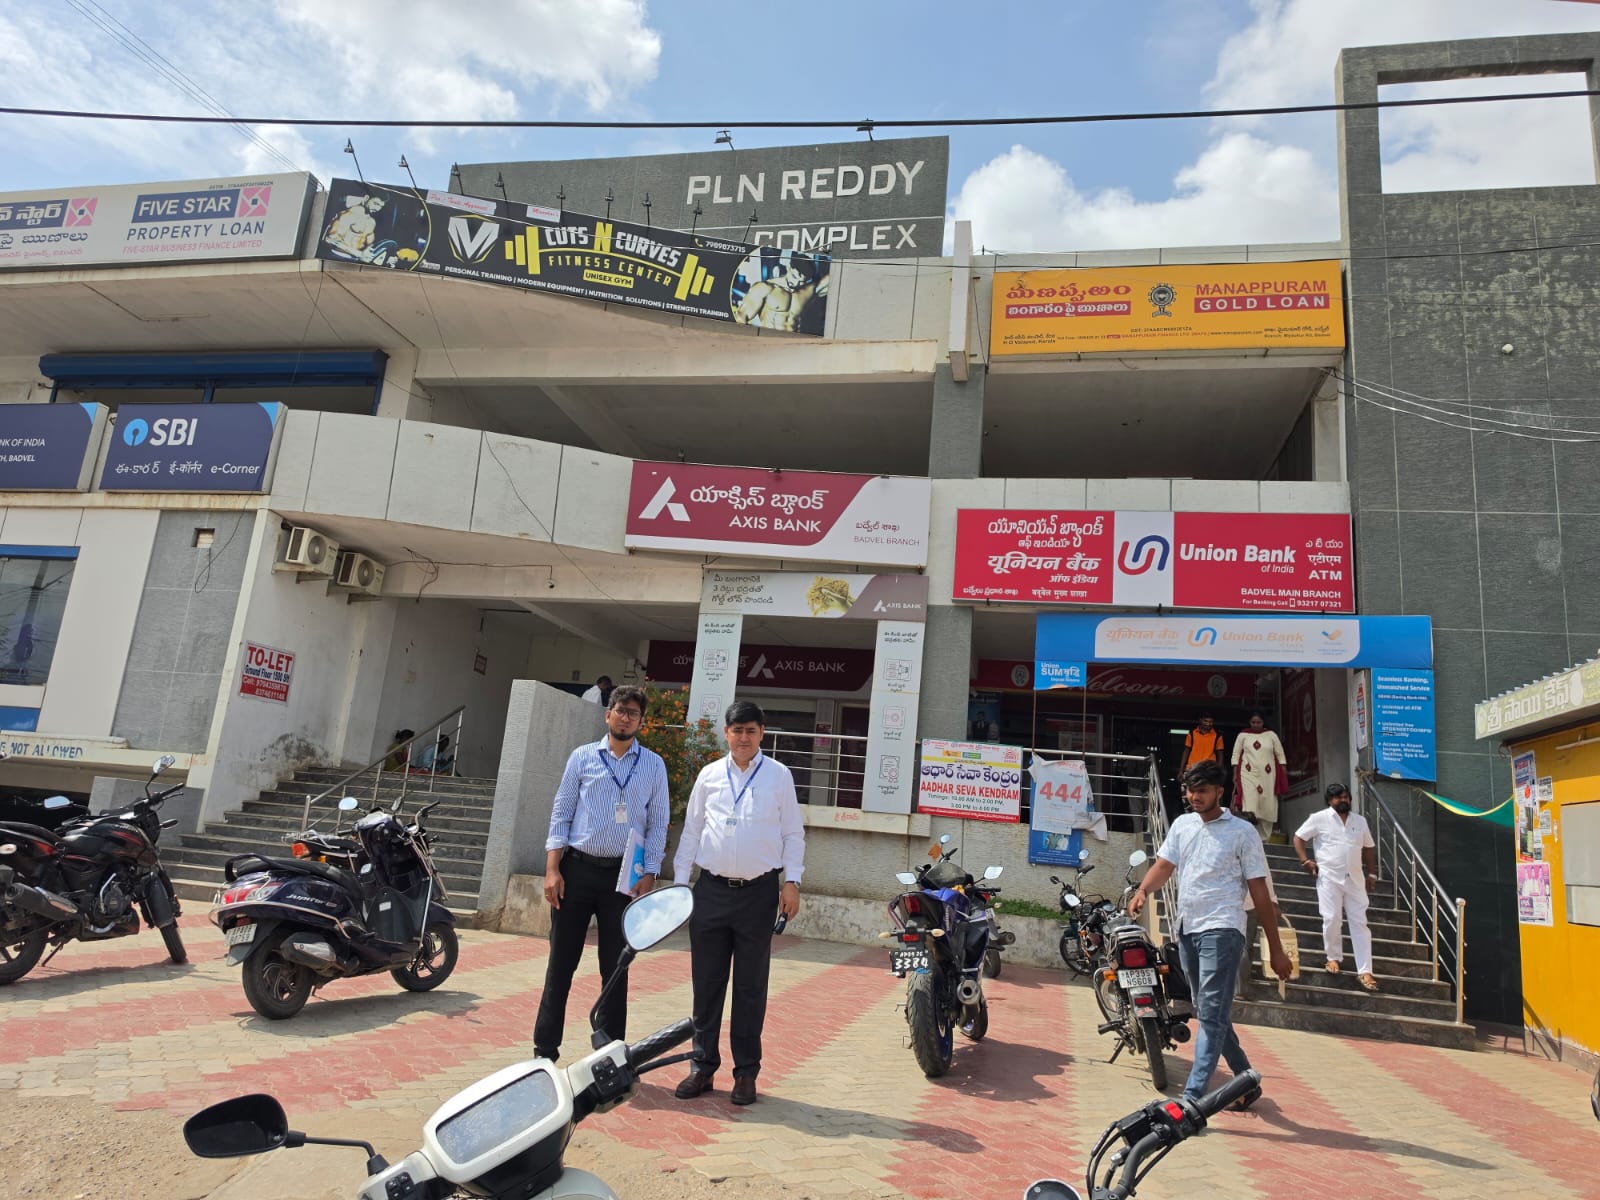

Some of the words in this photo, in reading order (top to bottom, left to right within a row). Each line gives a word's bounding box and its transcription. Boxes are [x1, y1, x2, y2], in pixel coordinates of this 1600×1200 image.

[686, 172, 765, 205] PLN
[780, 160, 925, 201] REDDY
[138, 200, 179, 217] FIVE
[182, 196, 232, 214] STAR
[126, 223, 213, 241] PROPERTY
[220, 220, 265, 236] LOAN
[754, 223, 917, 253] COMPLEX
[160, 242, 197, 252] BUSINESS
[198, 240, 232, 250] FINANCE
[232, 239, 263, 249] LIMITED
[544, 226, 588, 246] CUTS
[593, 221, 613, 253] N
[614, 231, 682, 268] CURVES
[548, 255, 611, 269] FITNESS
[618, 261, 673, 287] CENTER
[585, 271, 613, 283] UNISEX
[614, 274, 633, 286] GYM
[444, 265, 479, 278] PERSONAL
[480, 270, 513, 282] TRAINING
[517, 277, 546, 288] MODERN
[546, 282, 584, 295] EQUIPMENT
[588, 290, 623, 301] NUTRITION
[625, 296, 661, 308] SOLUTIONS
[665, 302, 698, 313] STRENGTH
[699, 306, 729, 319] TRAINING
[1195, 280, 1327, 296] MANAPPURAM
[1199, 298, 1258, 312] GOLD
[1266, 296, 1325, 309] LOAN
[149, 418, 199, 446] SBI
[11, 438, 23, 447] OF
[23, 438, 46, 447] INDIA
[8, 454, 36, 462] BADVEL
[210, 462, 260, 475] e-Corner
[690, 485, 766, 510] యాక్సిస్
[770, 489, 830, 516] బ్యాంక్
[729, 514, 768, 530] AXIS
[773, 517, 821, 533] BANK
[988, 514, 1058, 536] యూనియన్
[1059, 515, 1104, 548] బ్యాంక్
[854, 535, 885, 545] BADVEL
[886, 537, 920, 547] BRANCH
[1179, 543, 1238, 562] Union
[1244, 544, 1297, 564] Bank
[1307, 551, 1342, 566] एटीएम
[987, 551, 1062, 574] यूनियन
[1065, 552, 1102, 571] बैंक
[1260, 564, 1269, 573] of
[1271, 564, 1295, 574] India
[1308, 569, 1343, 581] ATM
[1240, 587, 1276, 597] BADVEL
[1278, 588, 1301, 598] MAIN
[1302, 589, 1341, 599] BRANCH
[1222, 631, 1264, 642] Union
[1267, 631, 1304, 643] Bank
[774, 660, 804, 671] AXIS
[808, 661, 846, 673] BANK
[1409, 684, 1431, 692] Service
[11, 742, 30, 755] NOT
[921, 763, 955, 780] ఆధార్
[956, 763, 982, 781] సేవా
[982, 765, 1020, 788] కేంద్రం
[920, 780, 954, 795] AADHAR
[955, 784, 977, 797] SEVA
[978, 786, 1019, 801] KENDRAM
[1039, 781, 1083, 804] 444
[894, 957, 929, 970] 3384
